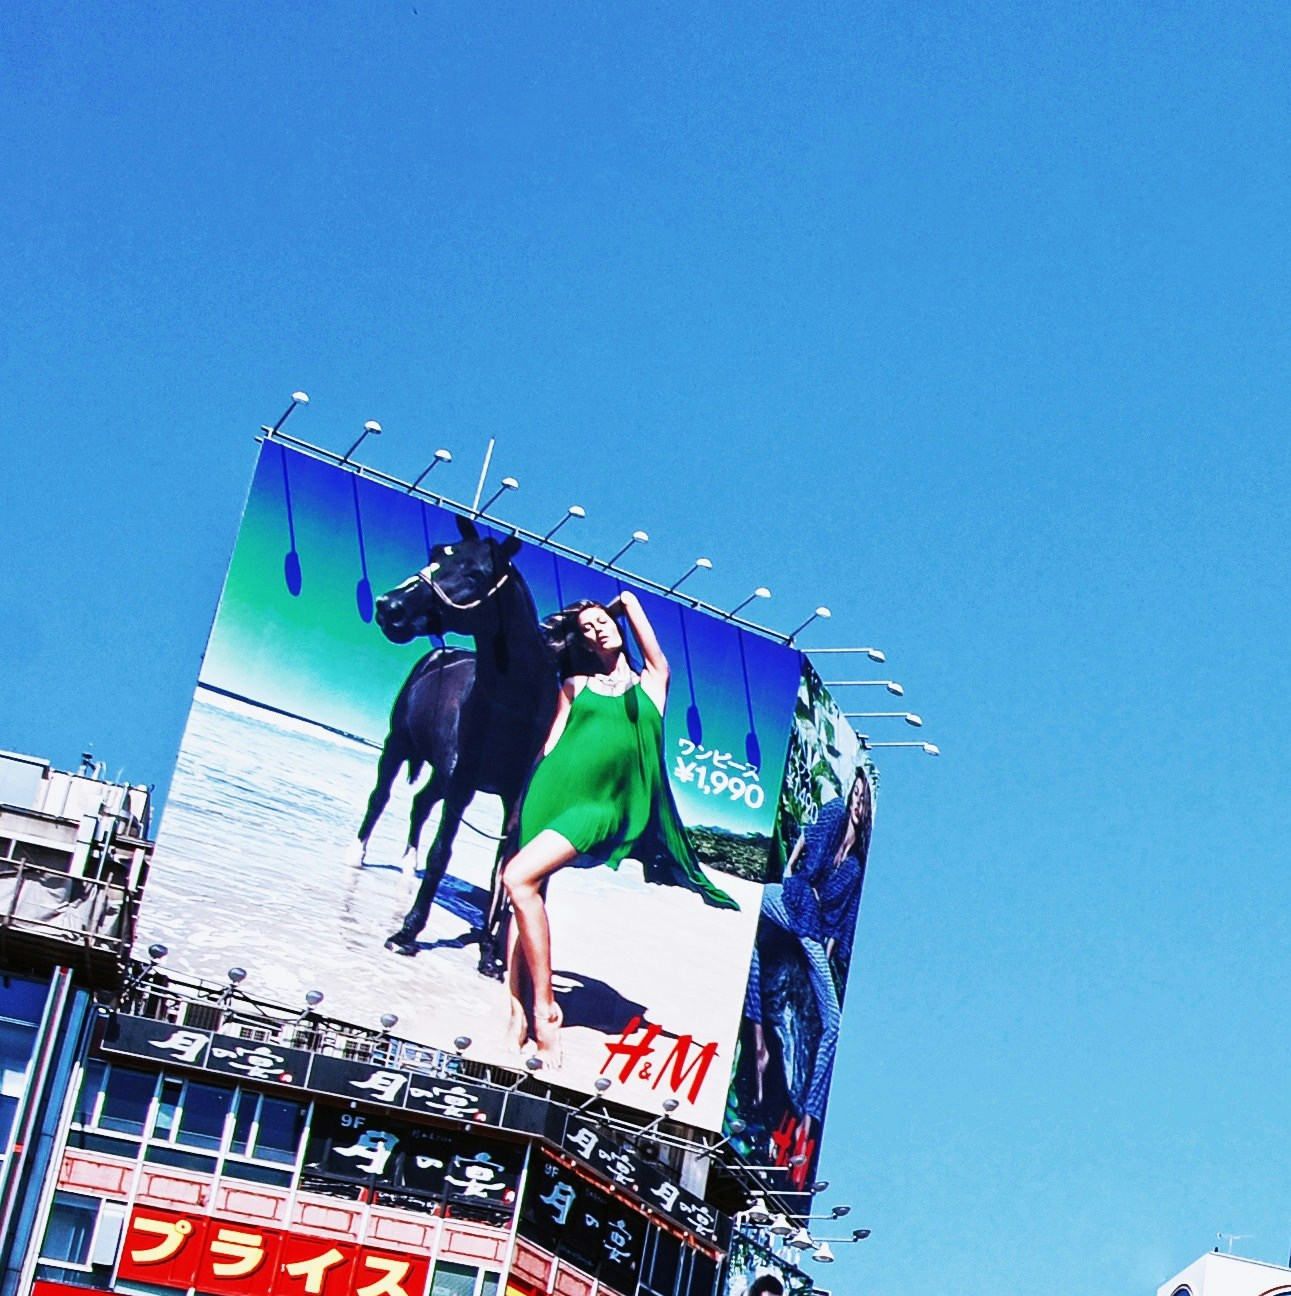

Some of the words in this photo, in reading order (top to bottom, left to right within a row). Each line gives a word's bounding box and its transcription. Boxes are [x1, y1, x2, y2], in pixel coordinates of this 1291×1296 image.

[674, 757, 764, 809] ¥1,990
[678, 738, 760, 782] ワンピース
[600, 1014, 721, 1105] H&M
[341, 1114, 366, 1129] 9F
